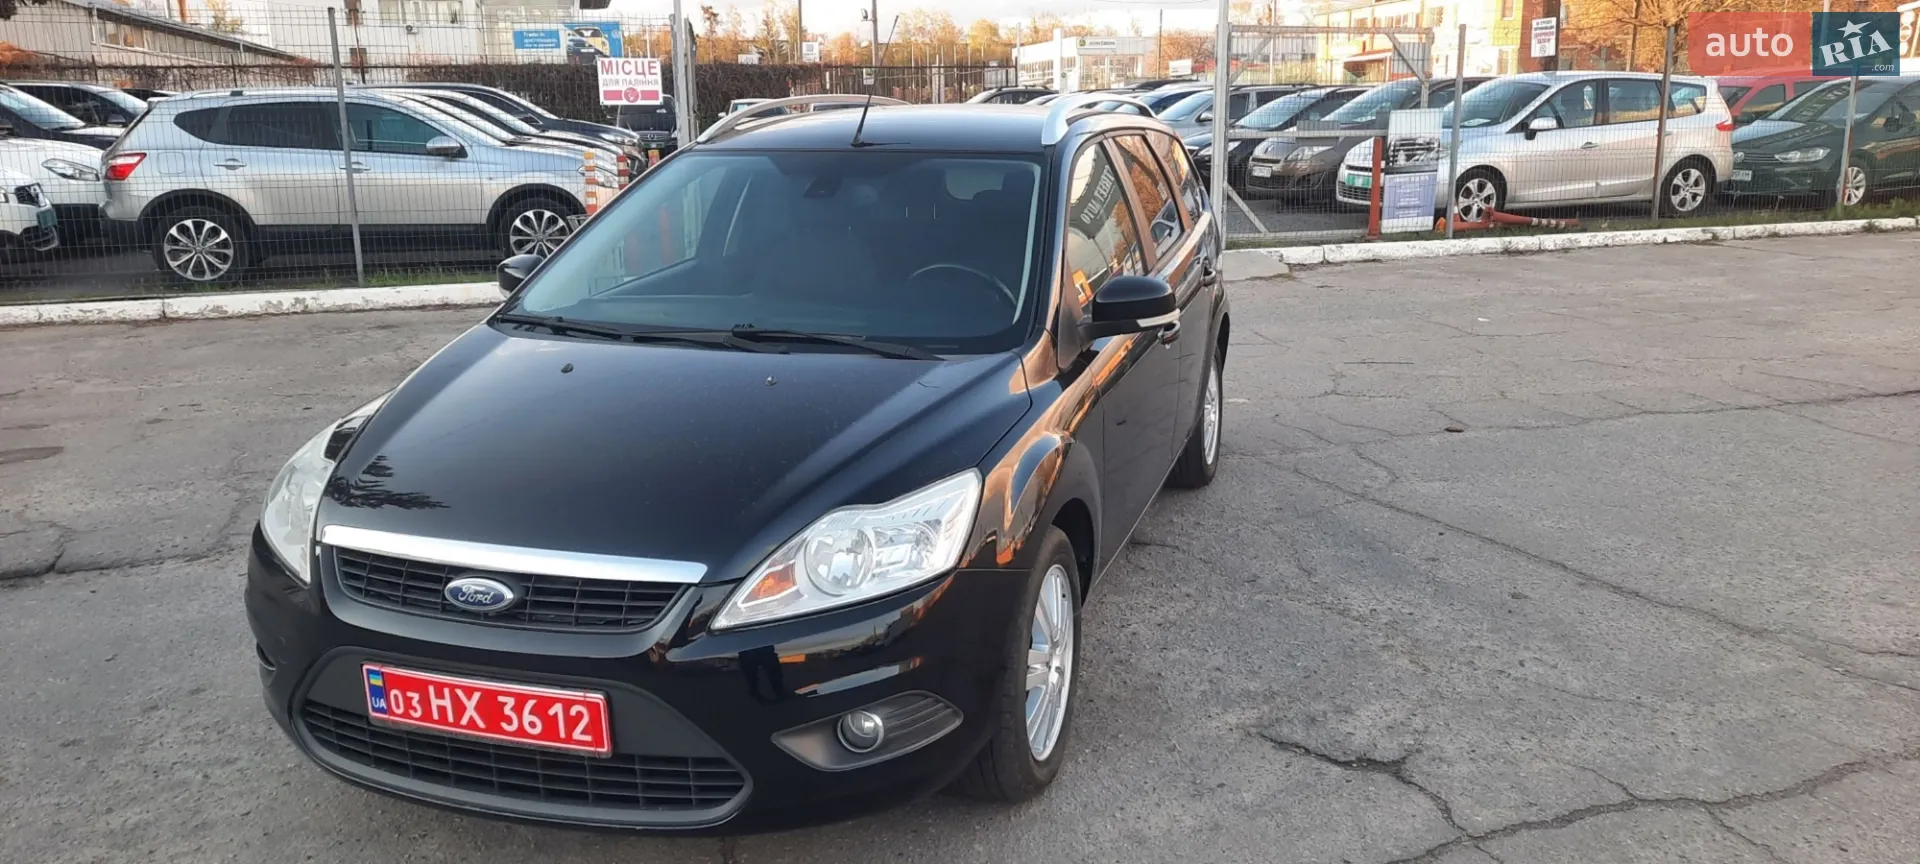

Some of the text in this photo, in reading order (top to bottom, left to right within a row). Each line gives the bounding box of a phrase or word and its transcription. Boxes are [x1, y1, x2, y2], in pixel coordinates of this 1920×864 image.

[601, 60, 658, 78] МІСЦЕ
[602, 78, 659, 87] ДЛЯ ПАЛІННЯ
[458, 584, 494, 604] Ford
[372, 696, 387, 710] UA
[497, 695, 593, 742] 3612
